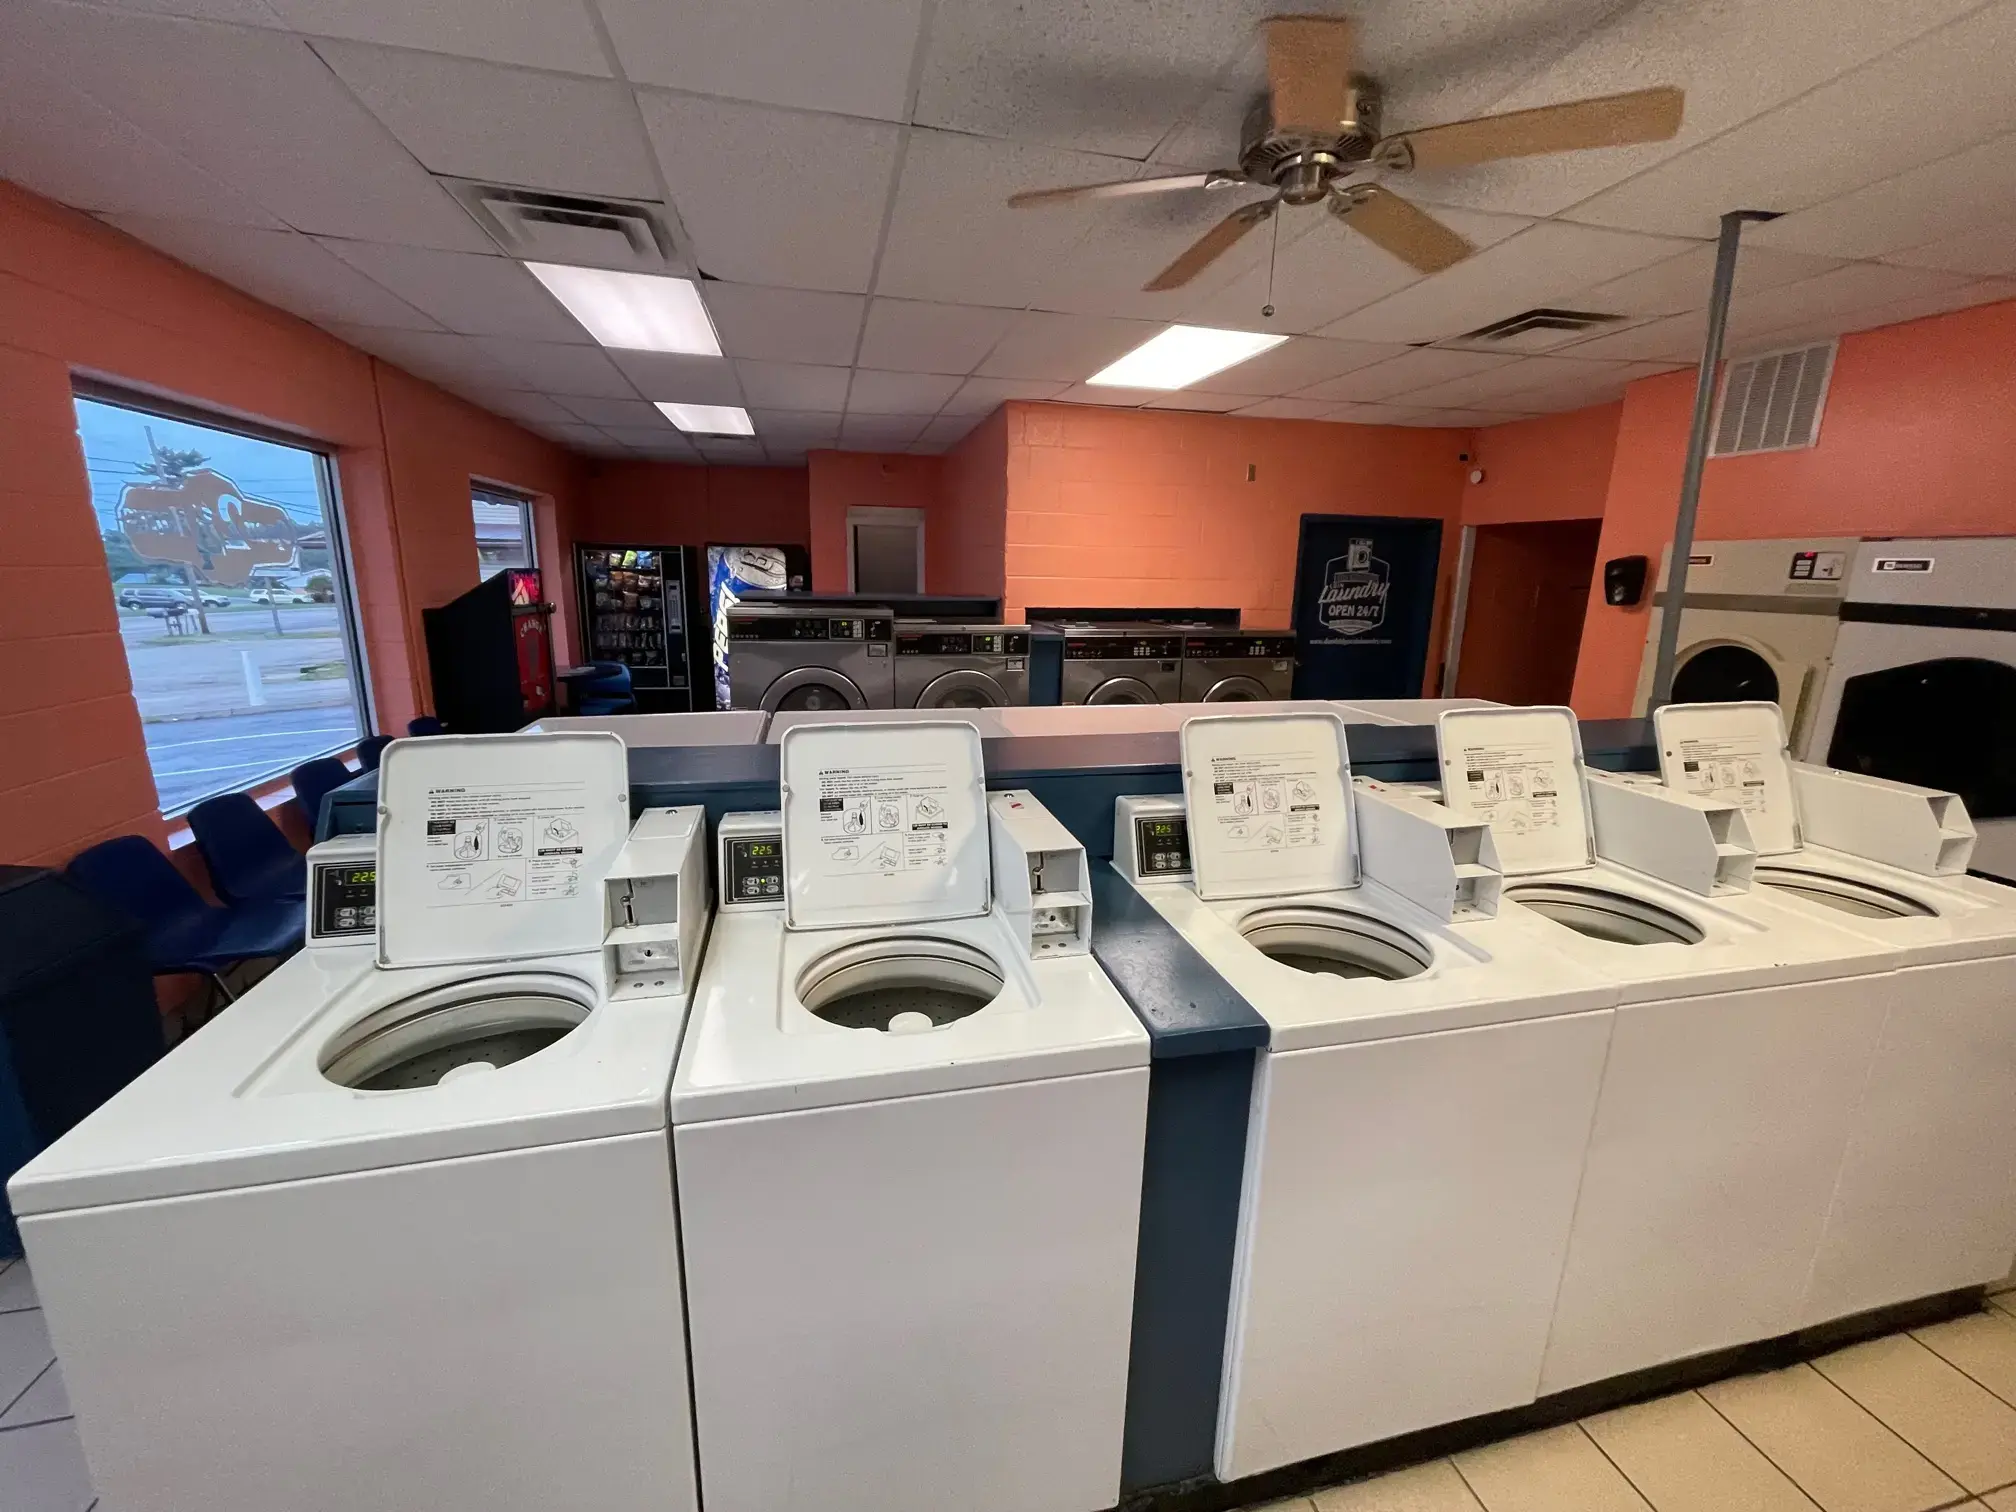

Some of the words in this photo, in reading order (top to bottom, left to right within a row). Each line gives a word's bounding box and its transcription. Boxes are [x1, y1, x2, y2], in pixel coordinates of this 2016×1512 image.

[1317, 579, 1391, 604] Laundry
[1328, 604, 1356, 617] OPEN
[1356, 605, 1380, 617] 24/7
[752, 845, 773, 856] 225
